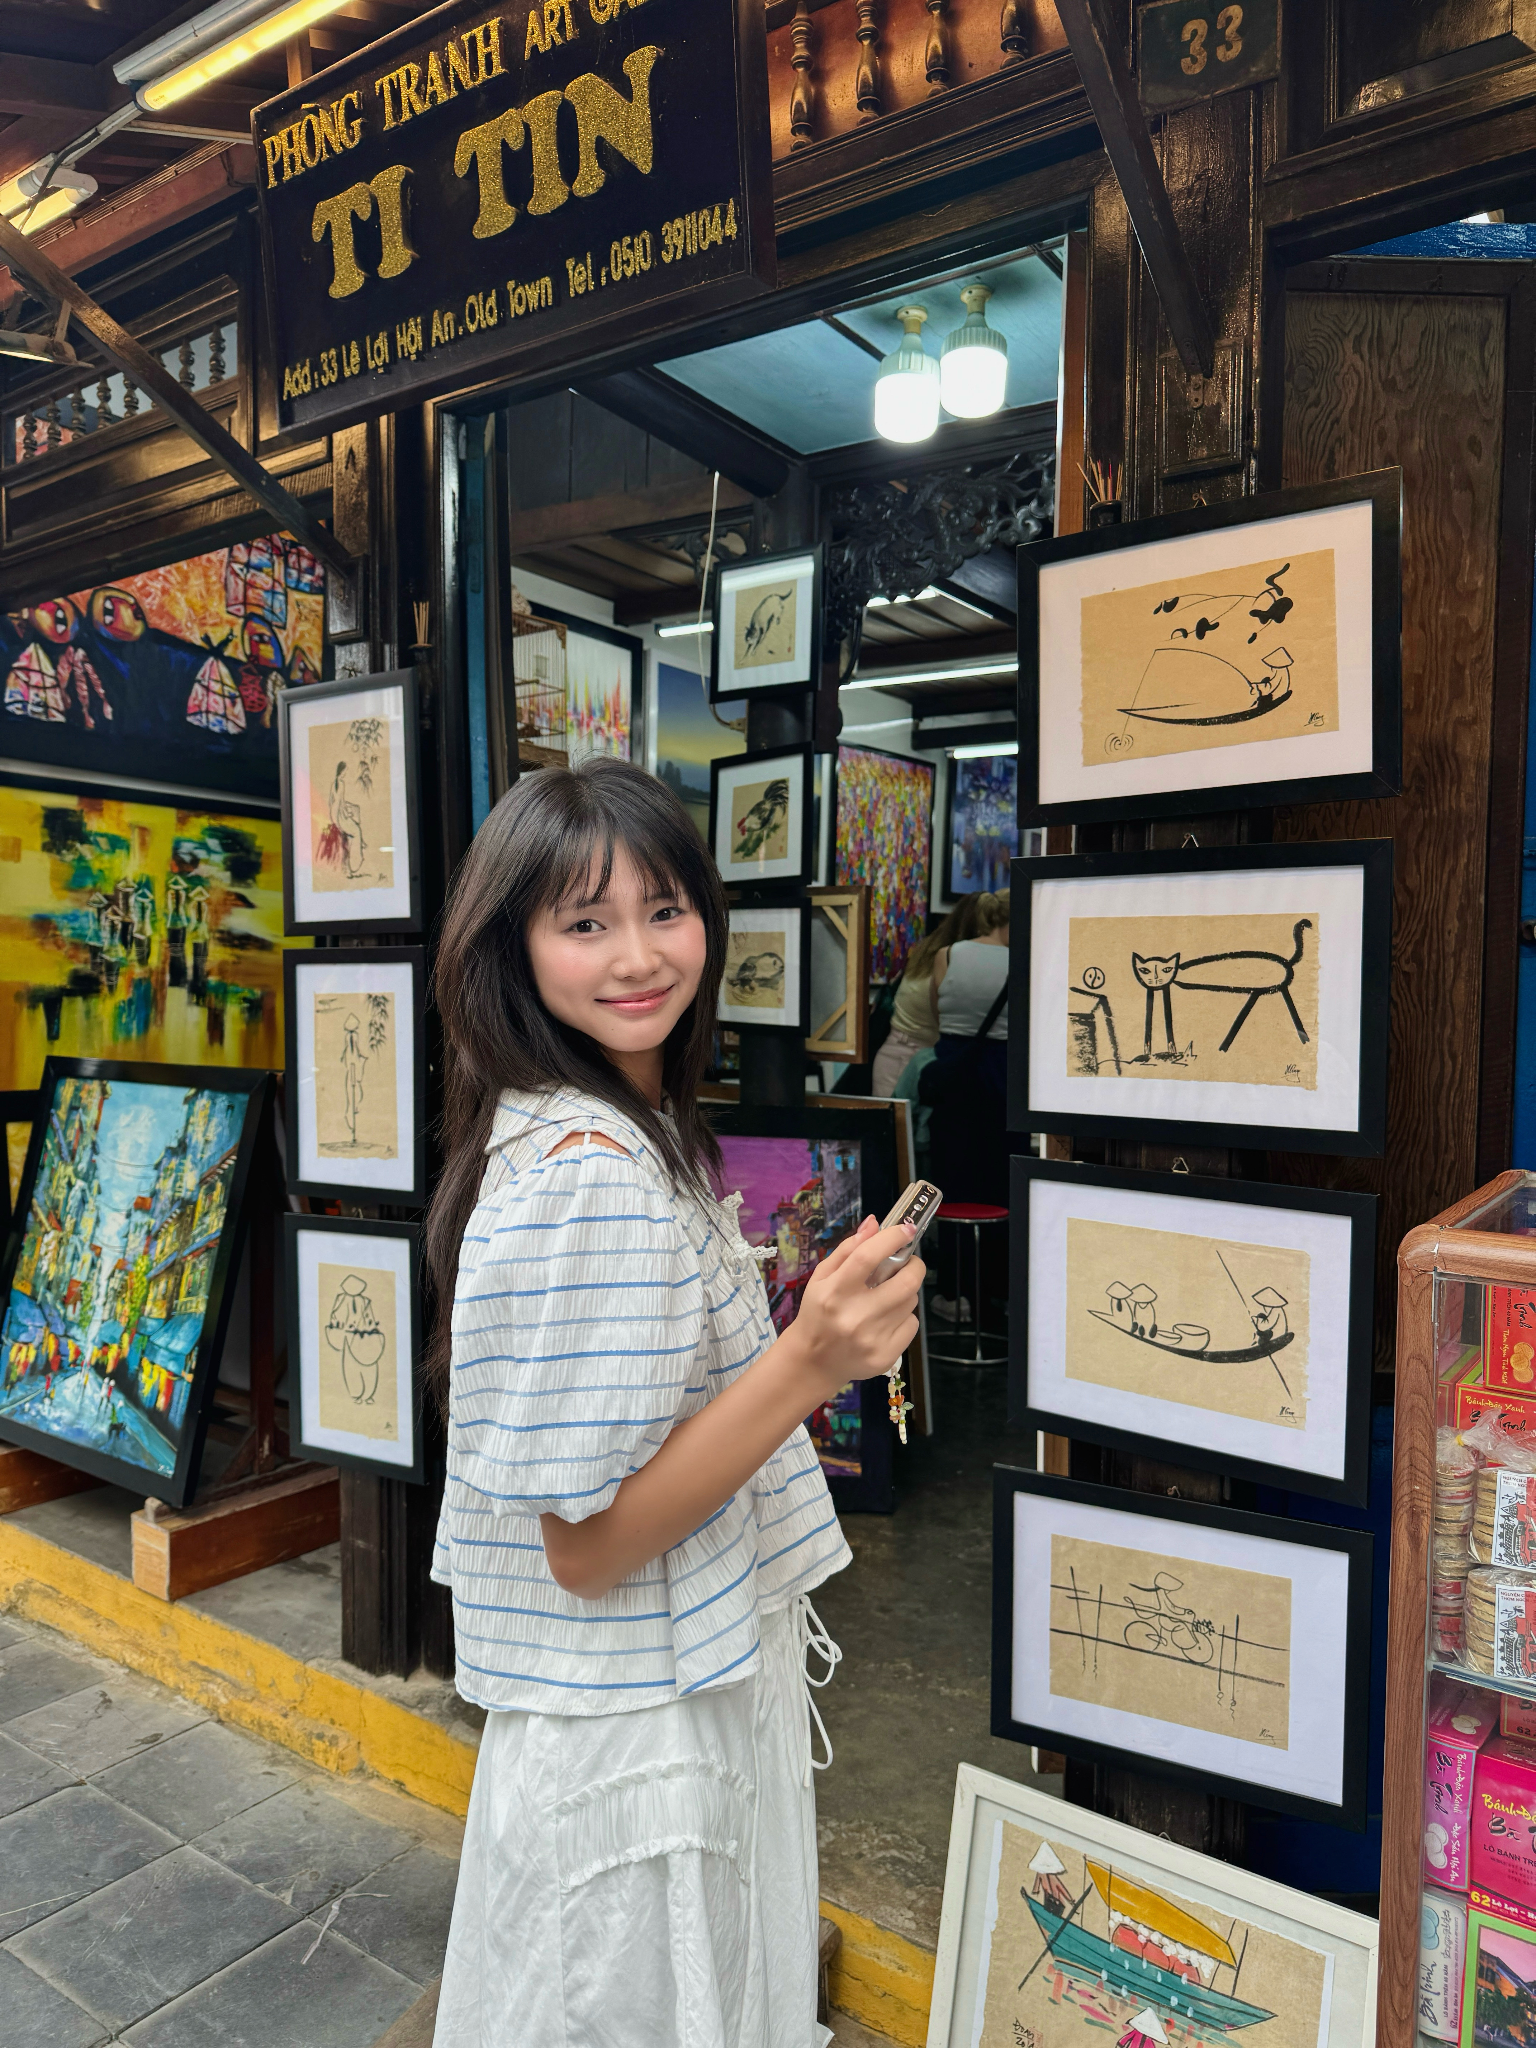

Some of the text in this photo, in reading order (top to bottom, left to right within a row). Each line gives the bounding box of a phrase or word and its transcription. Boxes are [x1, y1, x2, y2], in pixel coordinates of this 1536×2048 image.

[263, 0, 578, 189] PHÒNG TRANH ART
[1181, 4, 1244, 76] 33
[312, 46, 660, 299] TI TIN
[342, 340, 361, 378] Lê
[366, 331, 389, 373] Lợi
[396, 317, 422, 360] Hội
[465, 289, 498, 333] Old
[507, 276, 553, 318] Town
[610, 230, 652, 281] 0510
[662, 198, 737, 263] 3911044
[1470, 1890, 1491, 1908] 62
